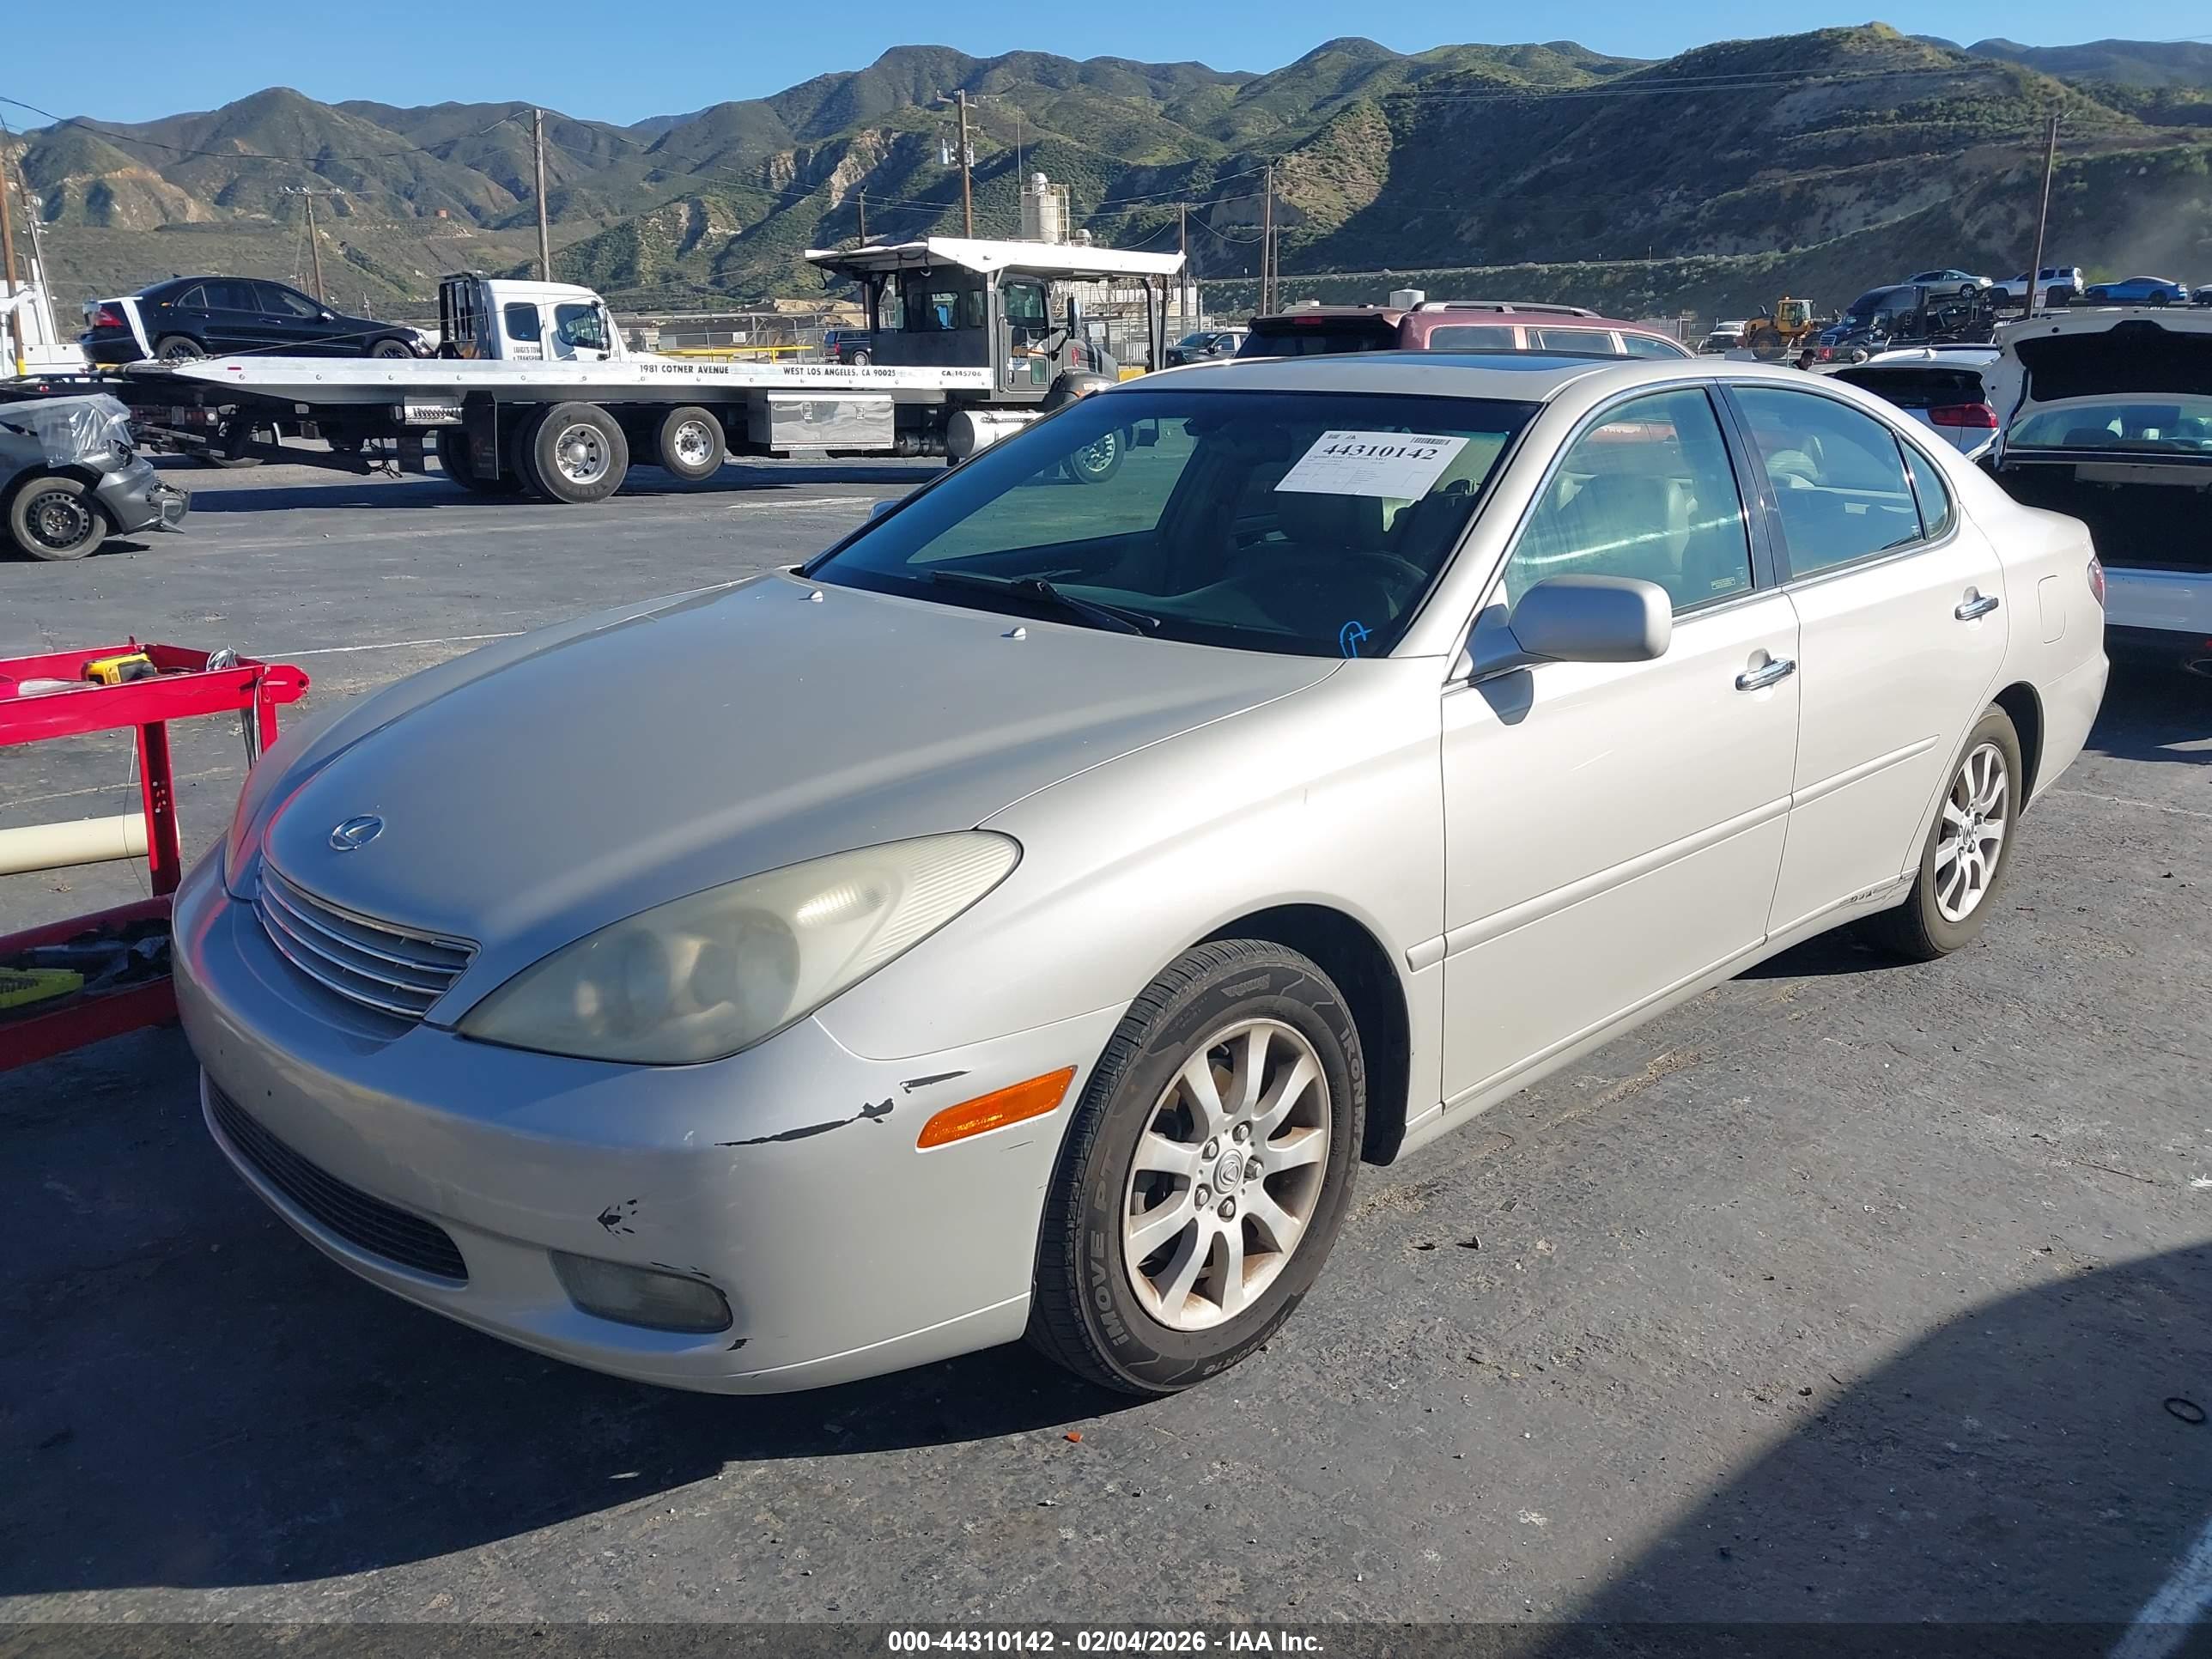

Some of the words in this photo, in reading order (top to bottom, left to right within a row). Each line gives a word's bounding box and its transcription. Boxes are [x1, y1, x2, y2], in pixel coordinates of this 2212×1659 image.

[640, 364, 658, 373] 1981
[661, 365, 694, 374] COTNER
[697, 365, 729, 374] AVENUE
[783, 367, 804, 375] WEST
[807, 368, 822, 376] LOS
[873, 368, 896, 377] 90025
[1322, 443, 1438, 461] 44310142
